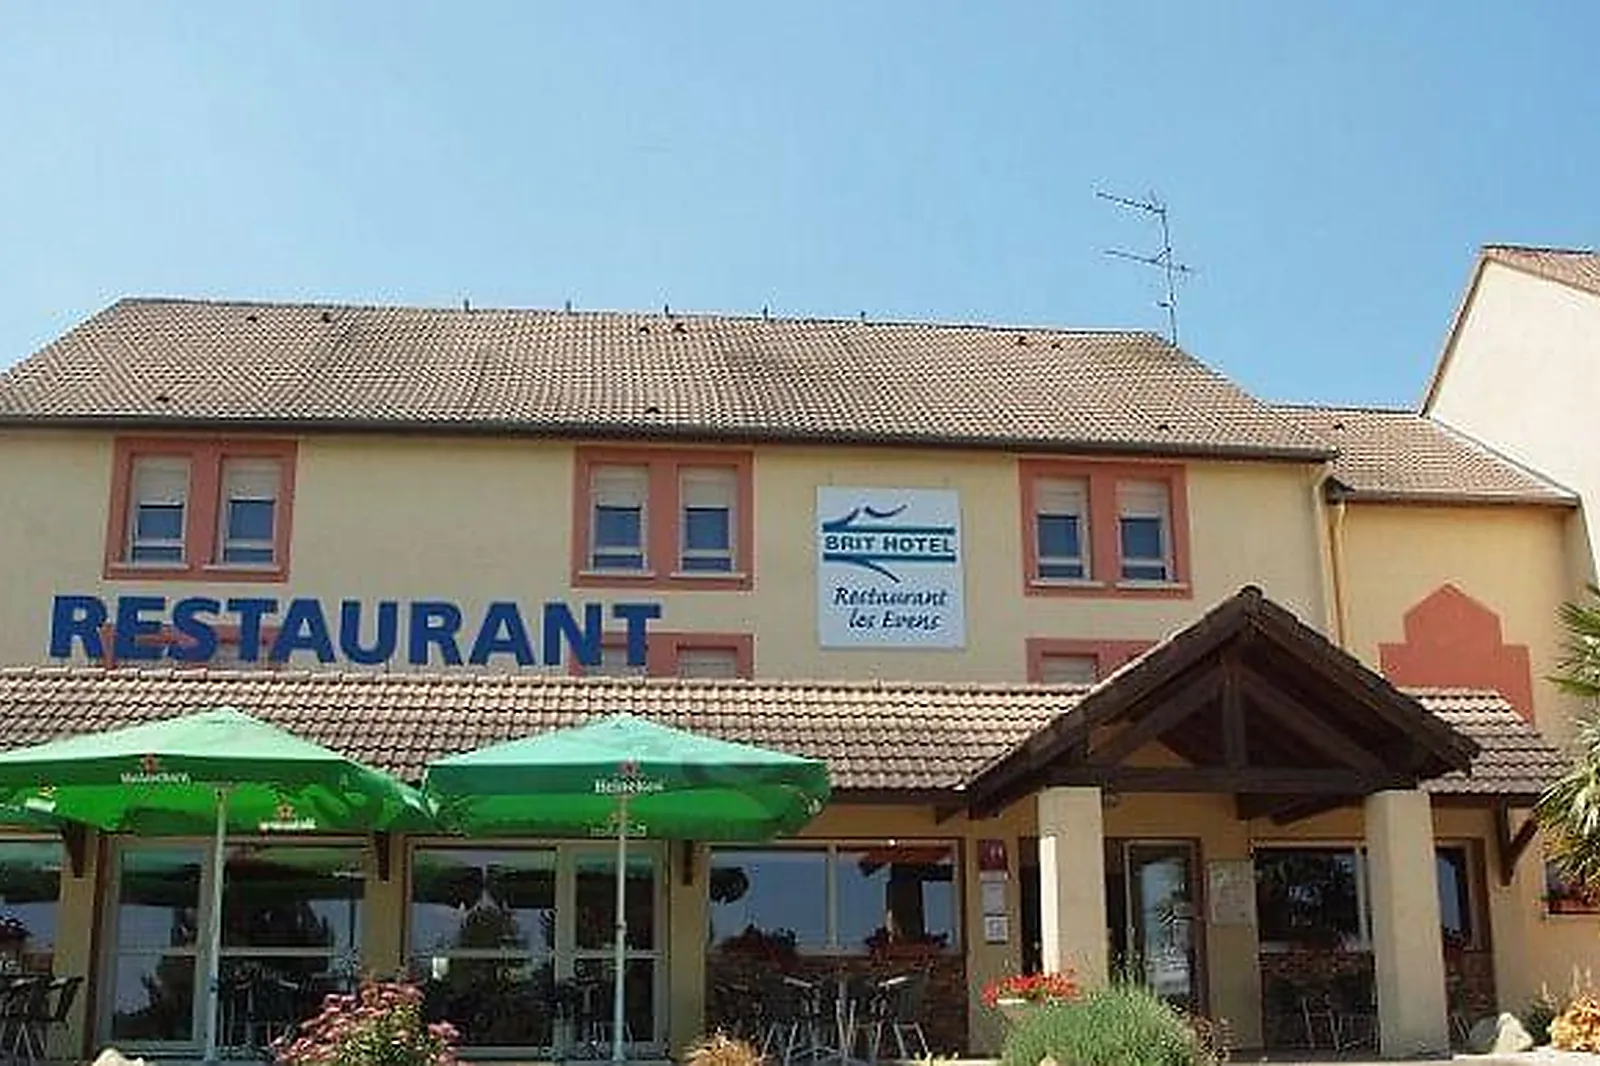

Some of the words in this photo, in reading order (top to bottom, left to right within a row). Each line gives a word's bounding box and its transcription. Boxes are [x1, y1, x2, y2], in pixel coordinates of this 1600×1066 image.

[825, 535, 875, 550] BRIT
[883, 537, 957, 553] HOTEL
[49, 595, 662, 666] RESTAURANT
